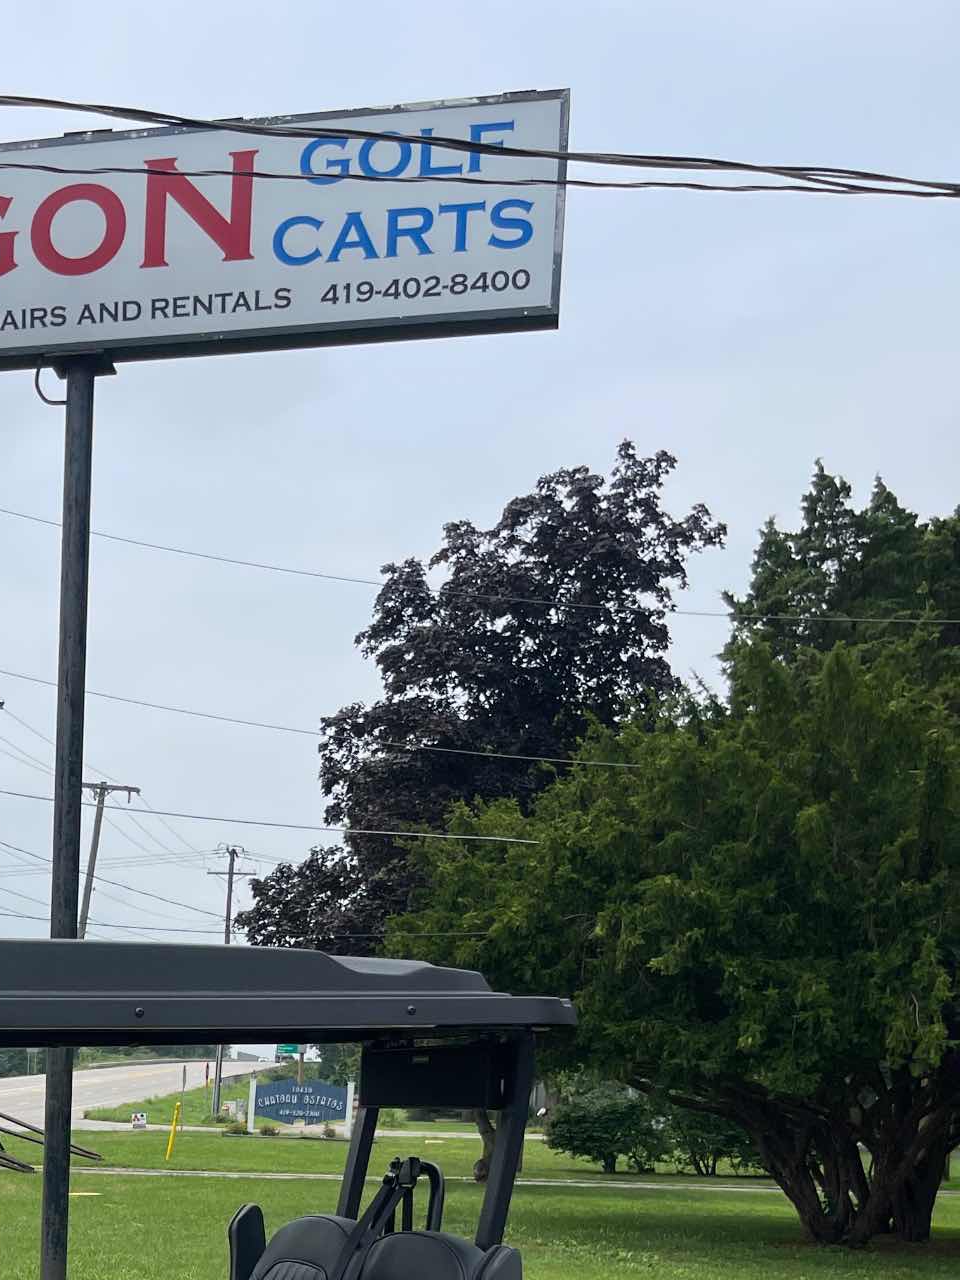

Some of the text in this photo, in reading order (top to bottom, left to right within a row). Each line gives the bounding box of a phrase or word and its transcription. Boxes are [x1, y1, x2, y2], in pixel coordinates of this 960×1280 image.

[300, 120, 515, 186] GOLF
[272, 198, 535, 266] CARTS
[77, 300, 141, 326] AND
[151, 287, 292, 319] RENTALS
[320, 269, 531, 305] 419-402-8400
